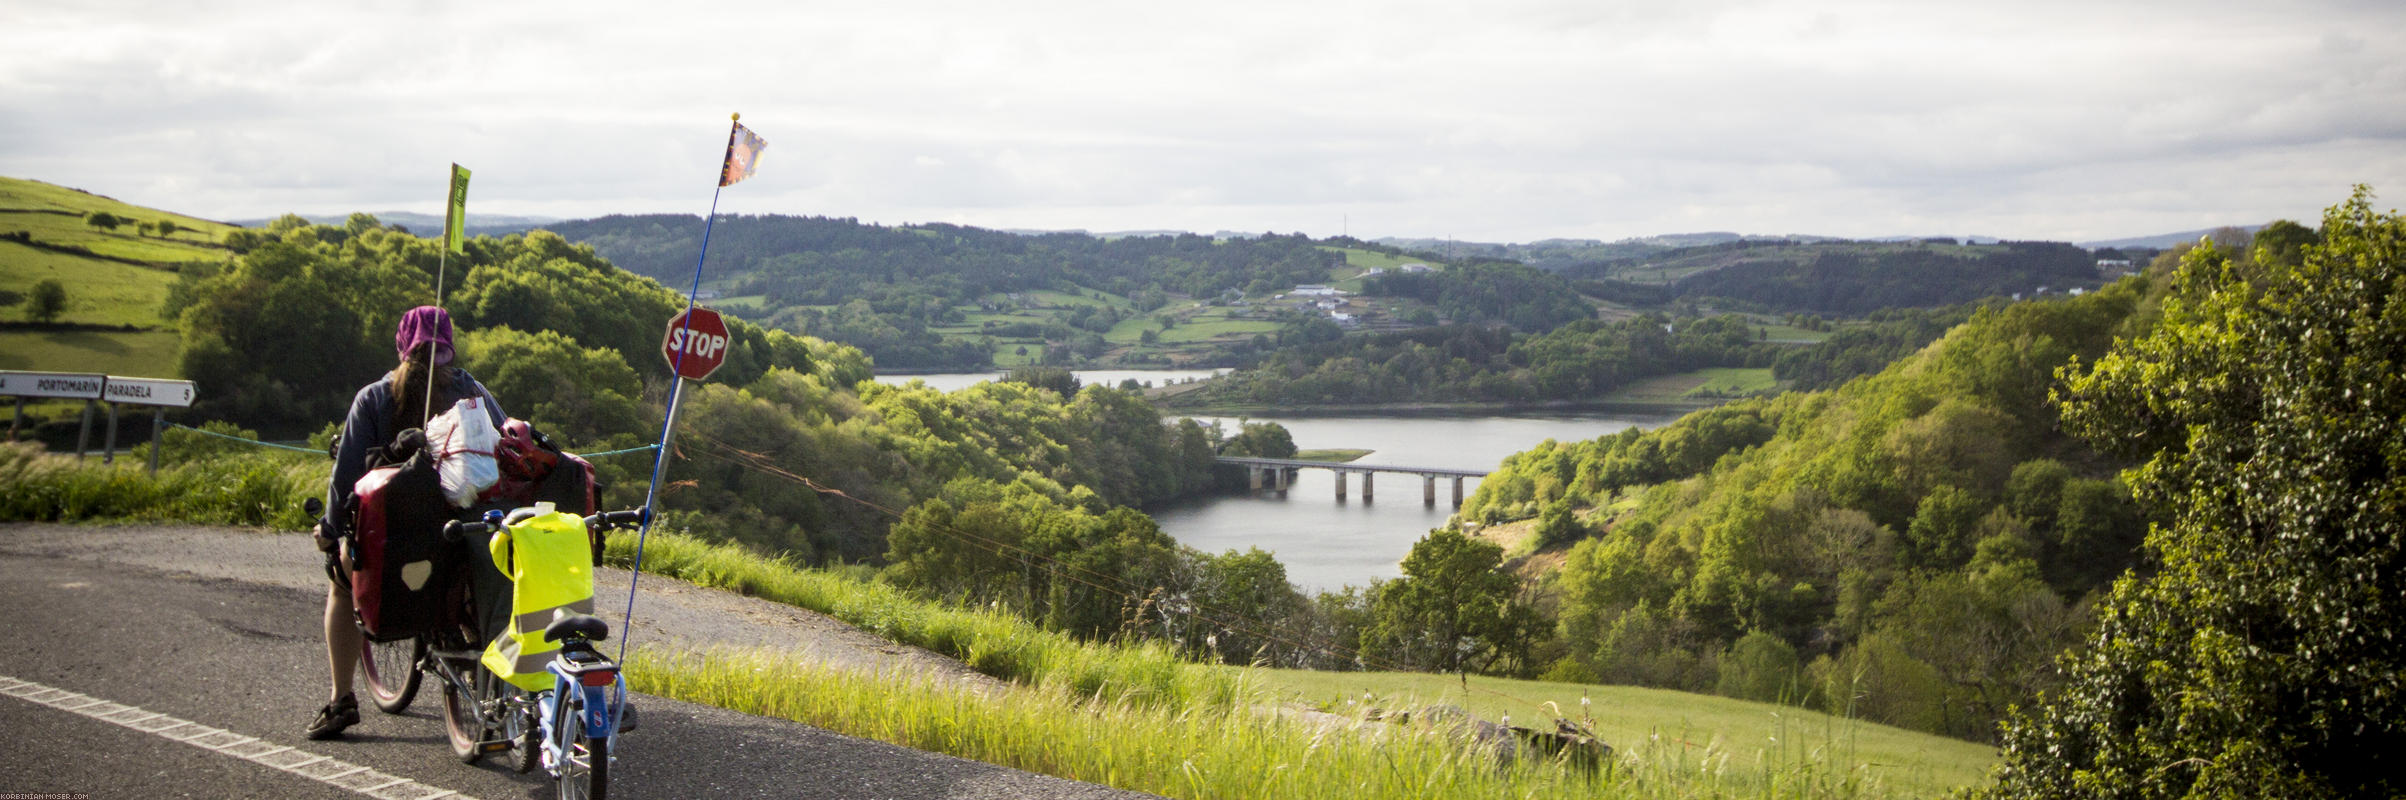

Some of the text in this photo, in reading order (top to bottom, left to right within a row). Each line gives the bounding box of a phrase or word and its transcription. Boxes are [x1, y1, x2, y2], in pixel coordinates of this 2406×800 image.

[669, 327, 725, 359] STOP
[107, 384, 190, 400] PARADELA 5
